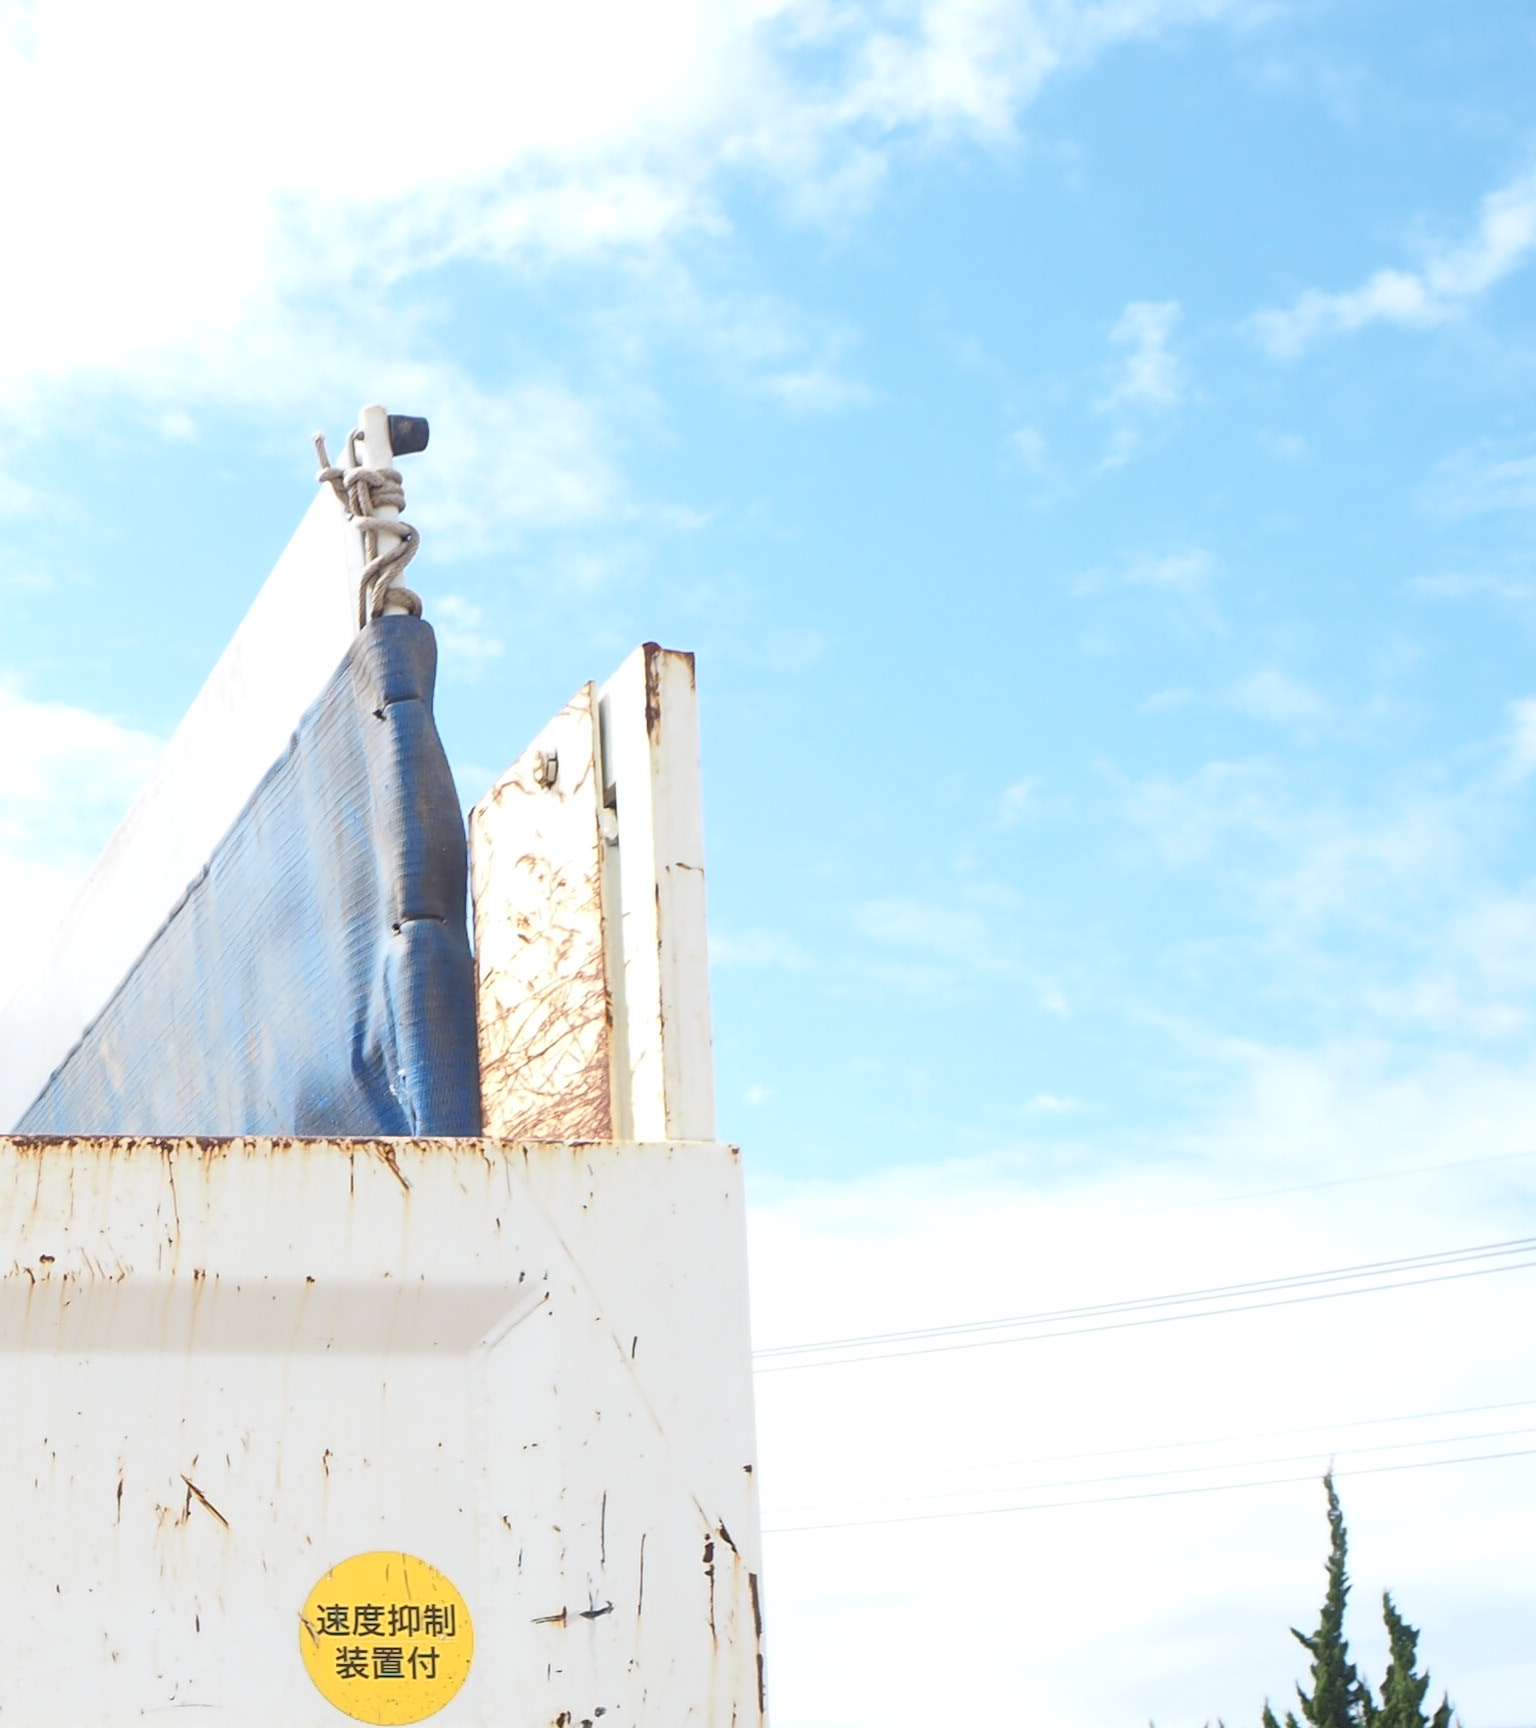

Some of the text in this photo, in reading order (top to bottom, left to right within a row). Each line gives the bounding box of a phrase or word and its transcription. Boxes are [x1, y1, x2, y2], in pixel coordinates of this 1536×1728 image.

[315, 1603, 457, 1638] 速度抑制
[334, 1645, 441, 1680] 装置付
